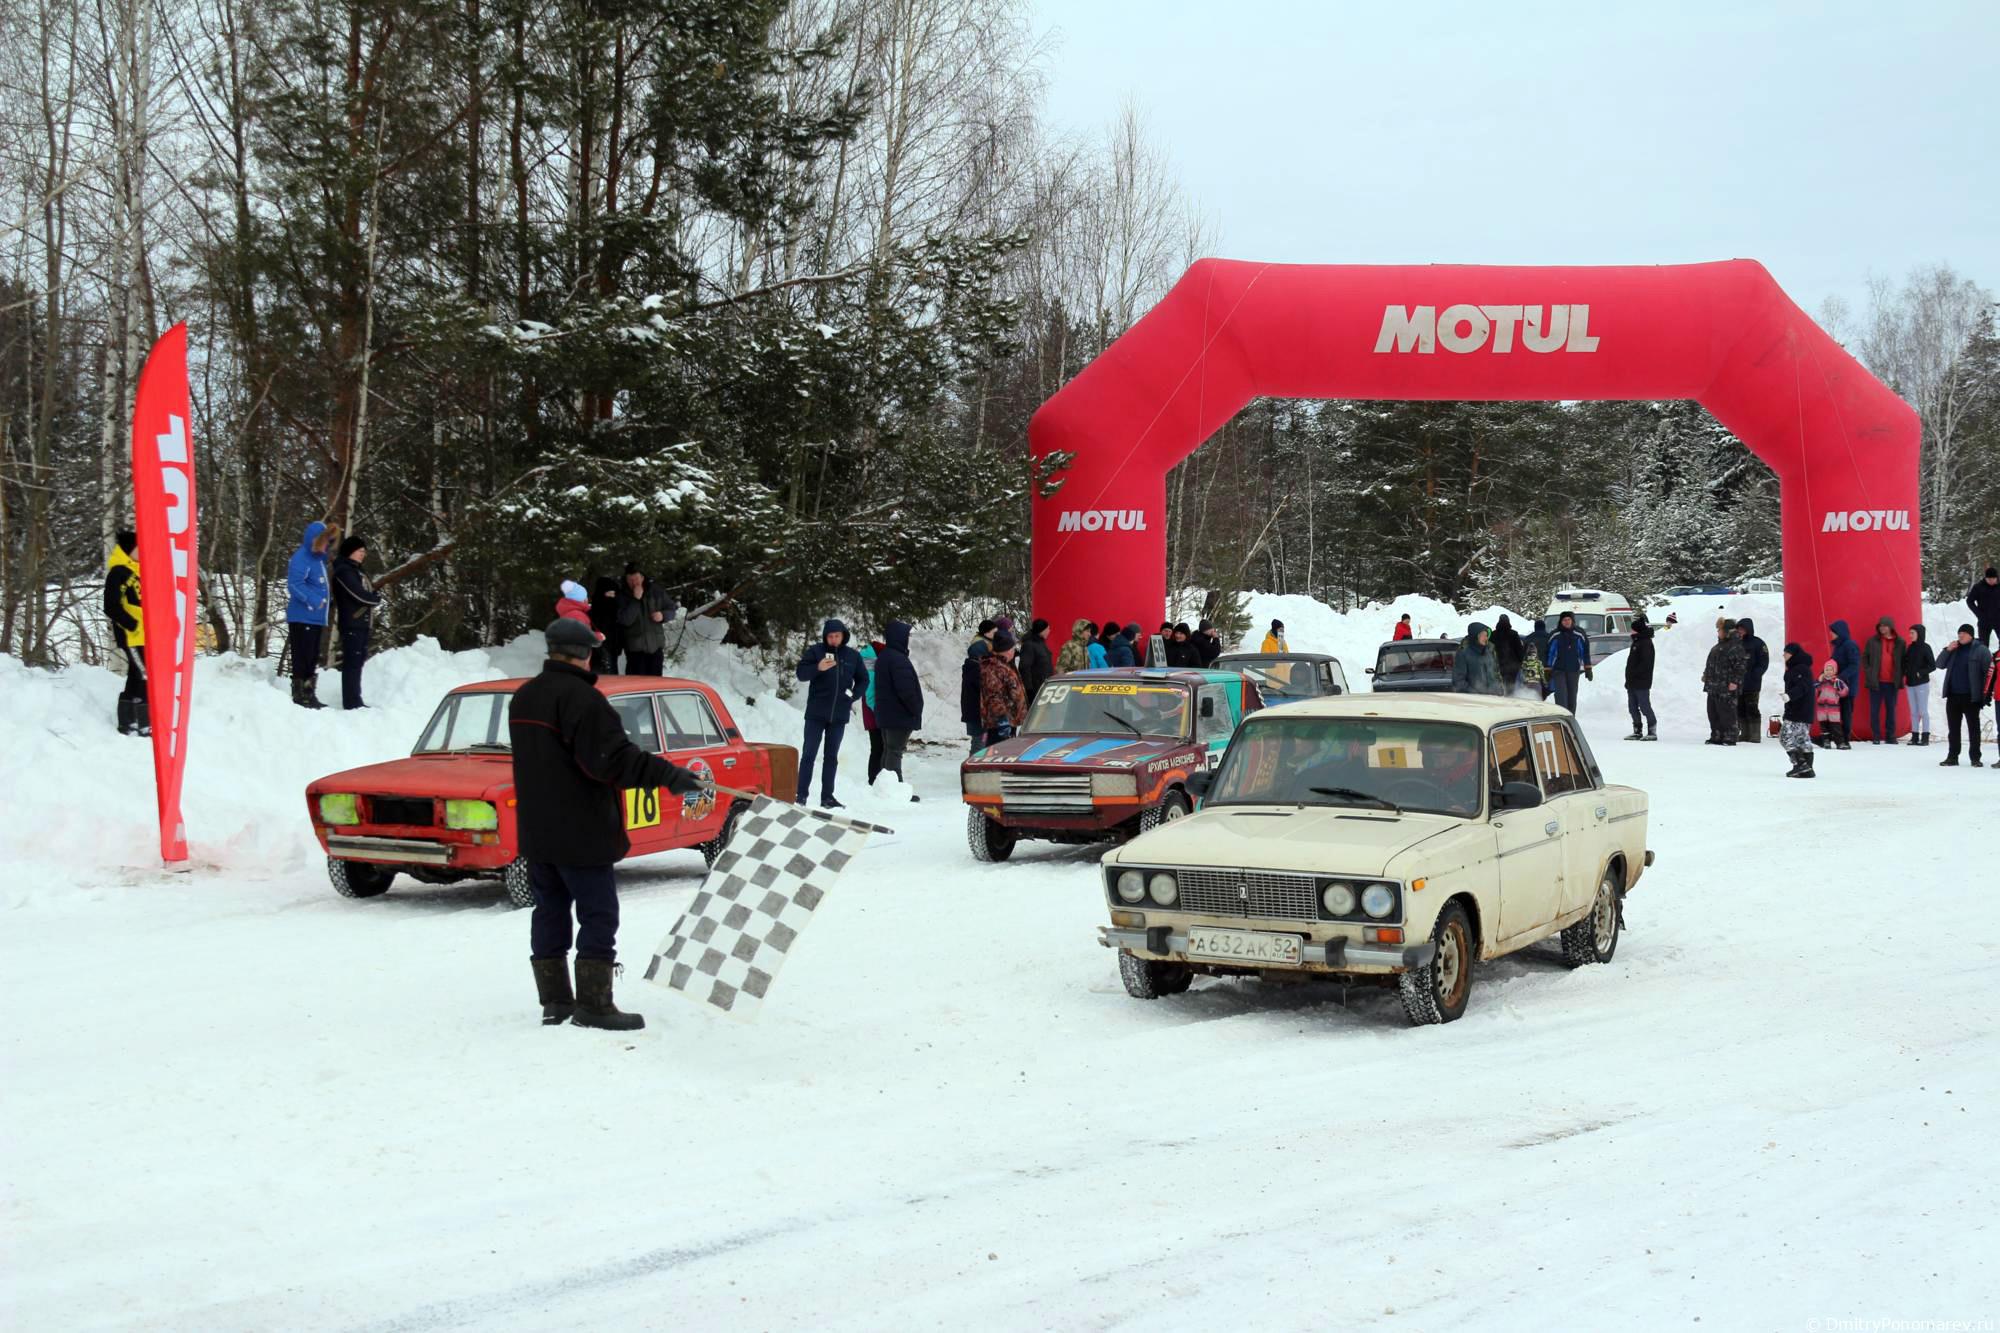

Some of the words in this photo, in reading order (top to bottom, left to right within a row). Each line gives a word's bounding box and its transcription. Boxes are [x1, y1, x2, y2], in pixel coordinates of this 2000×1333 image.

[1373, 303, 1601, 354] MOTUL
[1057, 509, 1147, 532] MOTUL
[1821, 509, 1911, 533] MOTUL
[1153, 638, 1167, 662] 59
[1037, 685, 1071, 706] 59
[1090, 685, 1132, 693] sparco
[1196, 934, 1269, 957] А632АК
[1273, 937, 1293, 953] 52
